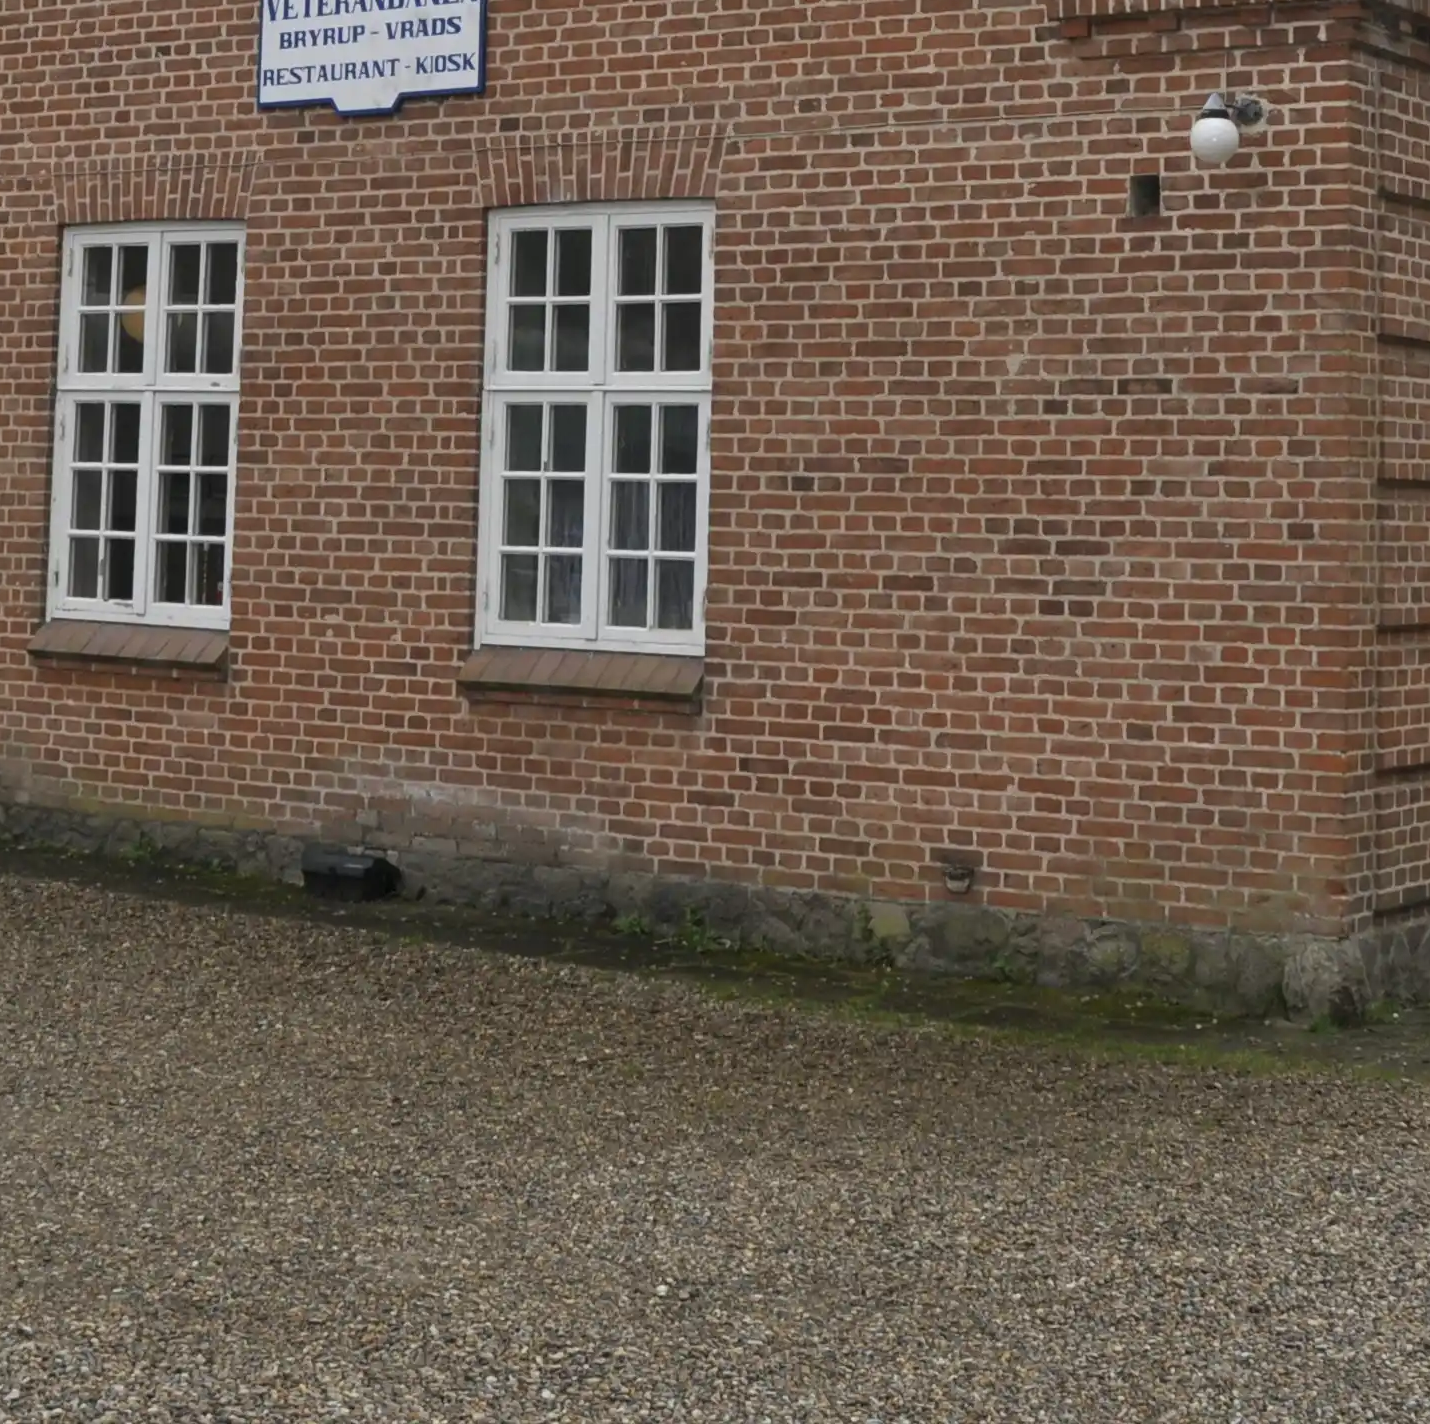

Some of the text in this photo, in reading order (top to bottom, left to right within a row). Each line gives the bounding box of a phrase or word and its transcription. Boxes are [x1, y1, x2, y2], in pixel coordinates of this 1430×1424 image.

[279, 24, 365, 49] BRYRUP
[385, 16, 462, 40] VRADS
[263, 58, 400, 87] RESTAURANT
[415, 52, 476, 75] KIOSK
